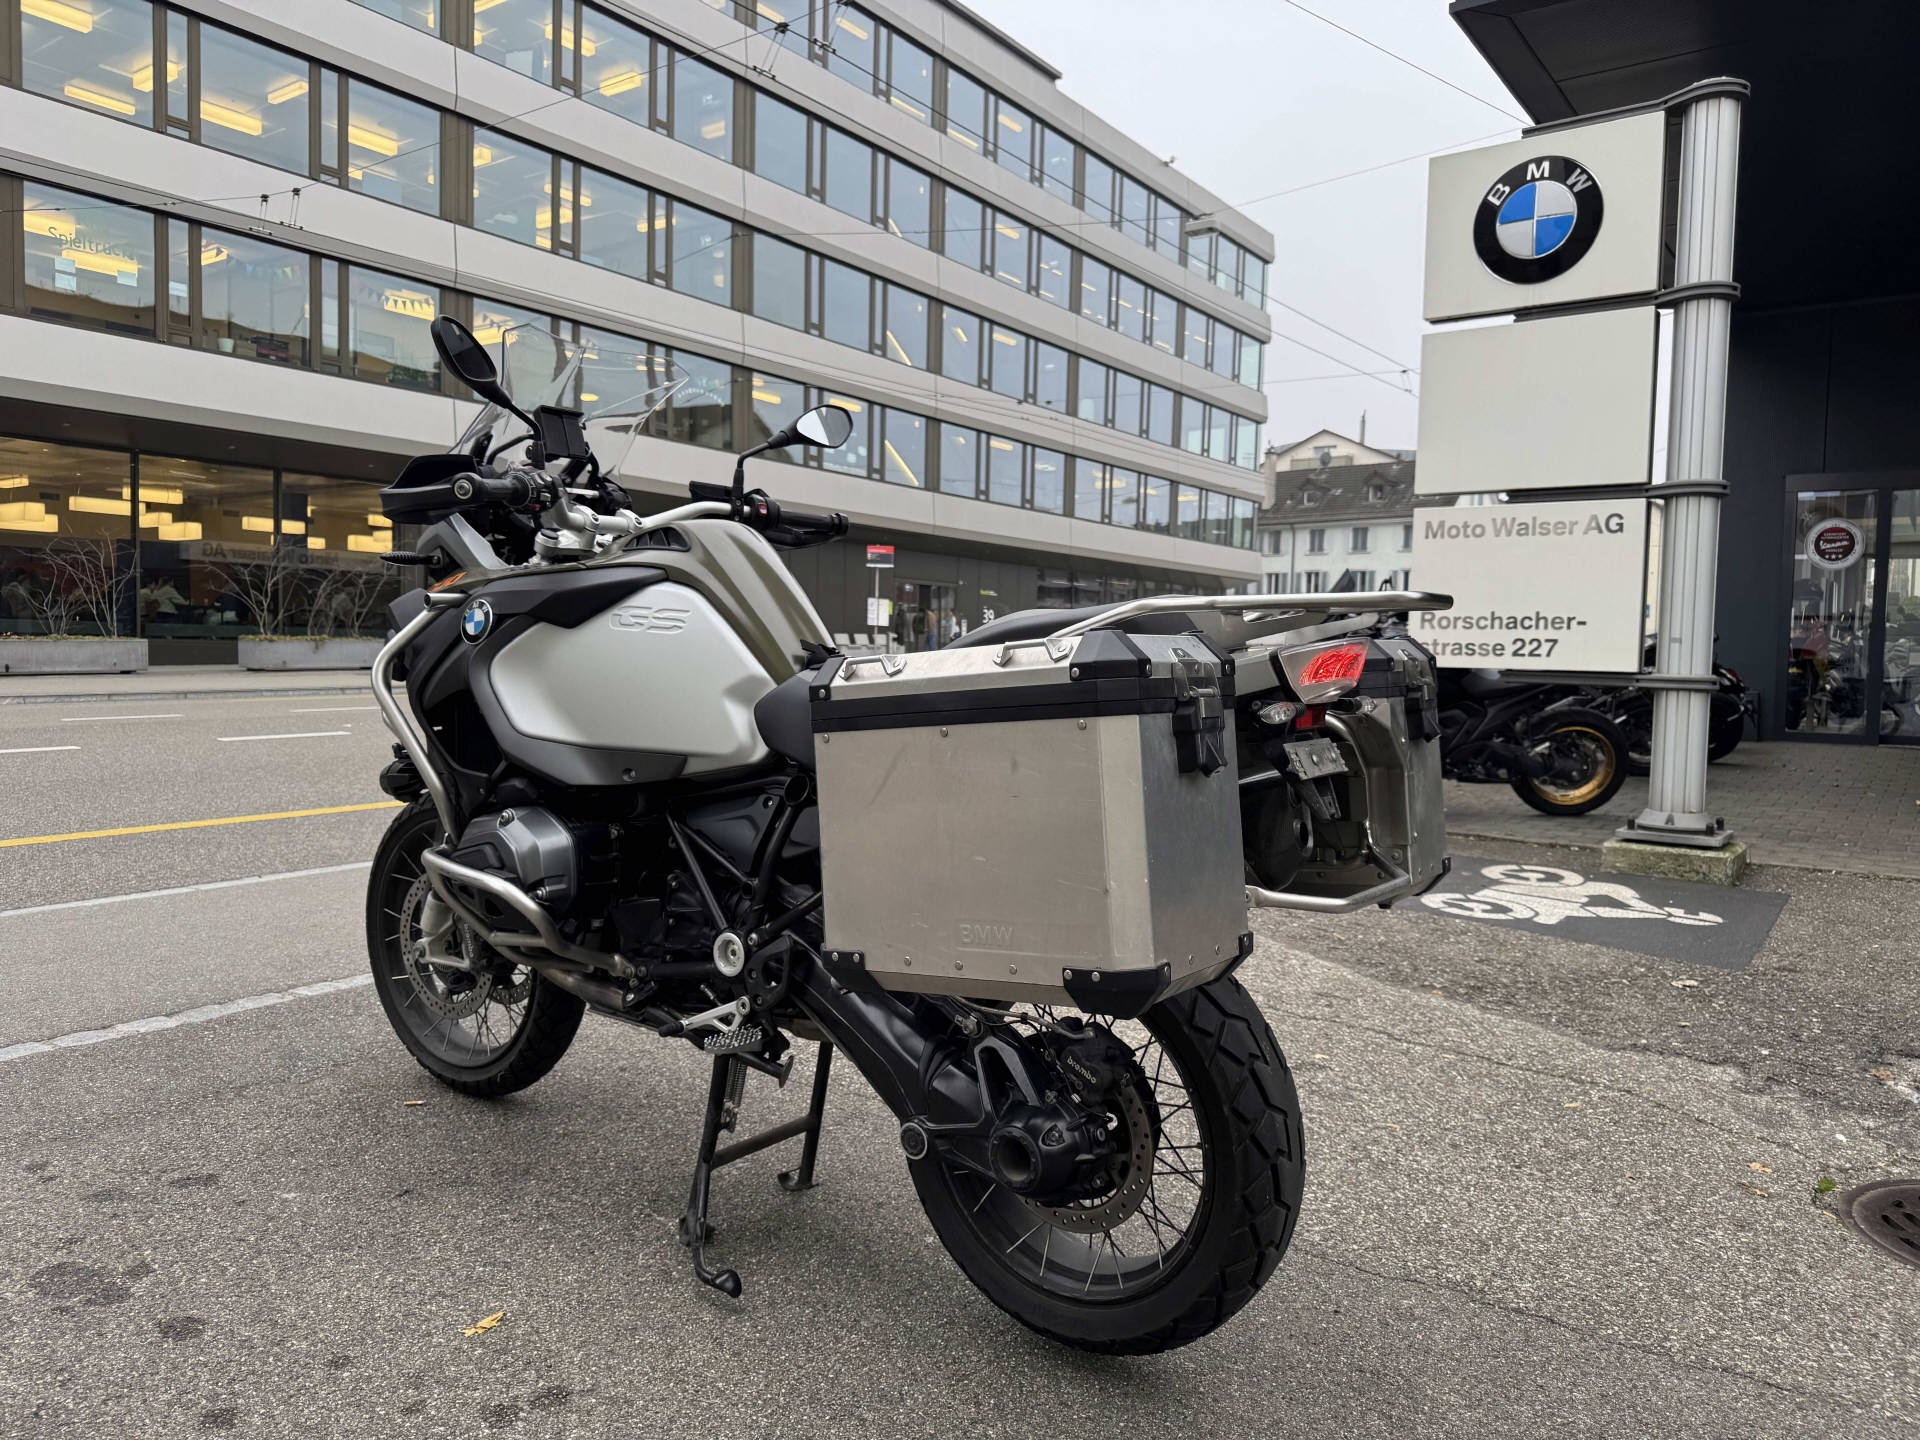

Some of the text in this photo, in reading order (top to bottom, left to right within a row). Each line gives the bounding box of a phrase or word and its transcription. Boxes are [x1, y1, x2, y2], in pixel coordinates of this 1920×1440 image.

[1487, 160, 1593, 207] BMW
[1424, 513, 1625, 541] Moto Walser AG
[609, 605, 692, 633] GS
[1420, 611, 1587, 631] Rorschacher-
[1511, 638, 1559, 658] 227
[958, 923, 1014, 945] BMW
[1066, 1055, 1097, 1084] brembo
